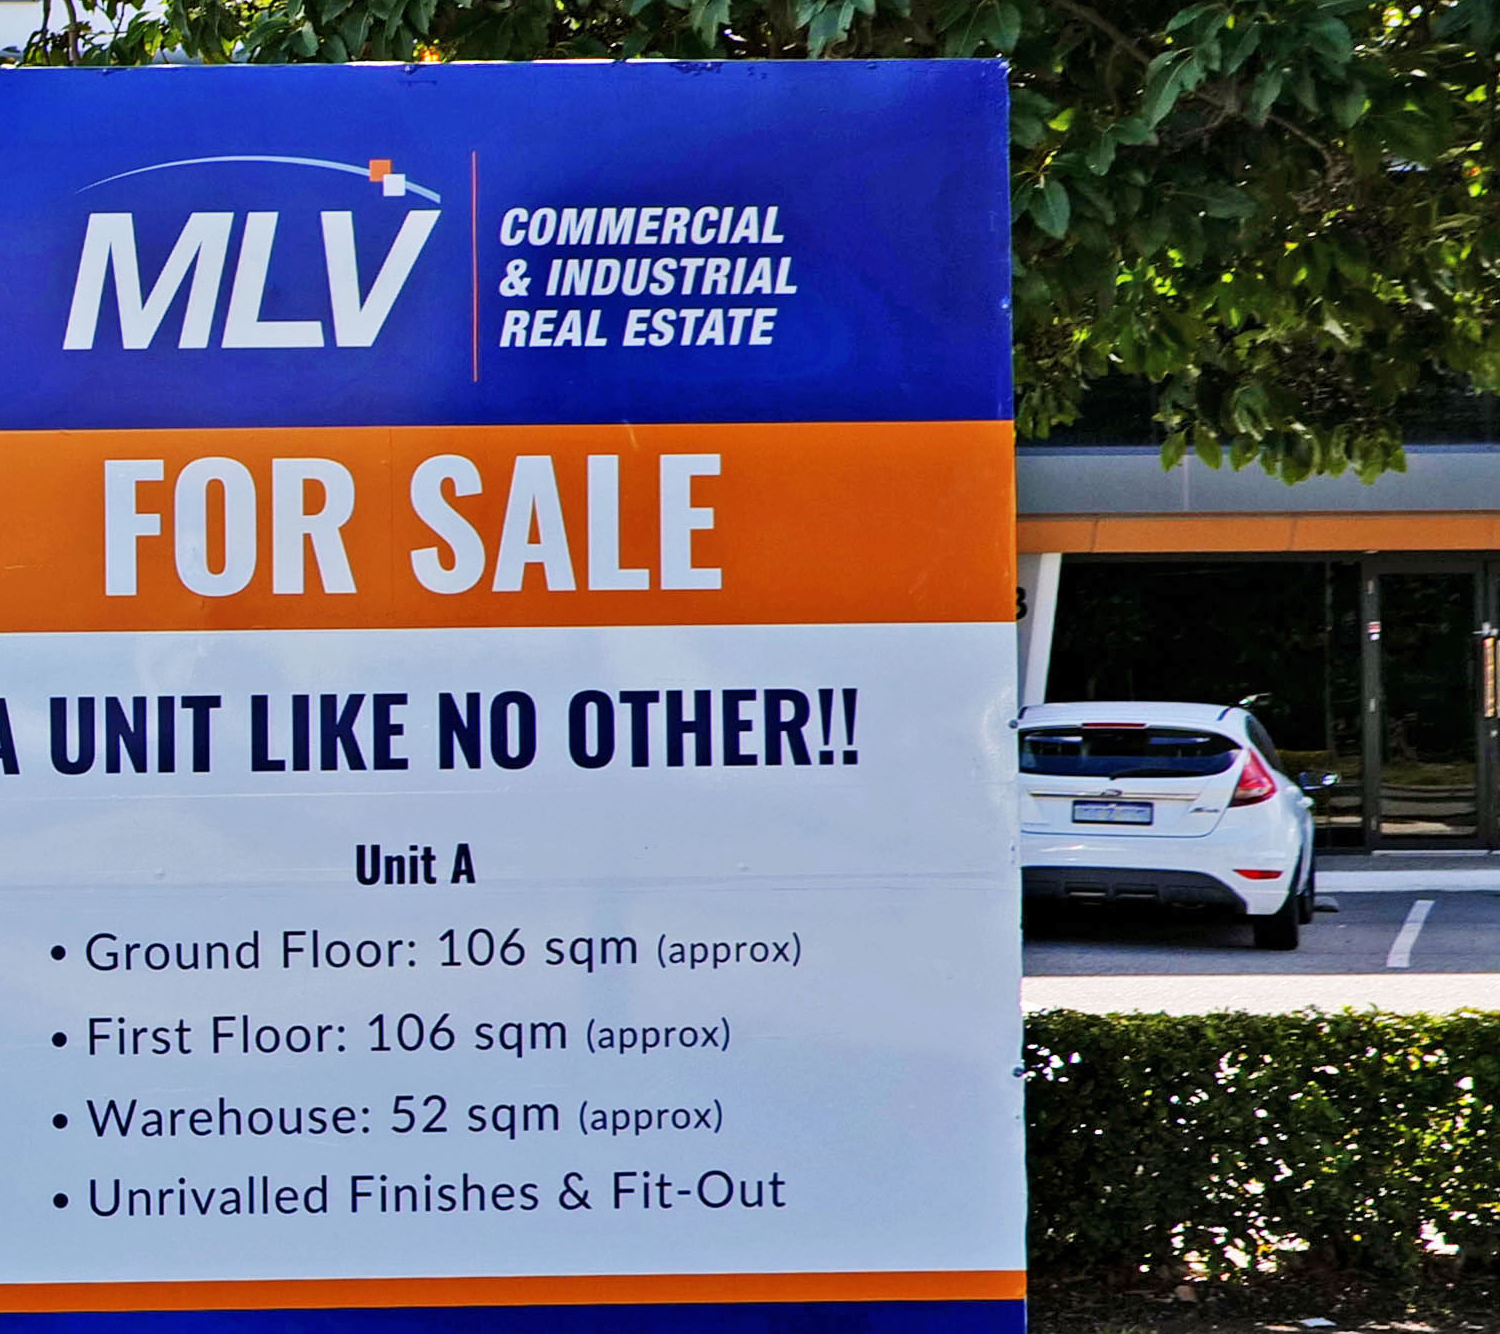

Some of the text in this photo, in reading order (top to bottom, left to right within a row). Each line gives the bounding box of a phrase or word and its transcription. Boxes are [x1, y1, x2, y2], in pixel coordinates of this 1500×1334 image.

[500, 206, 784, 247] COMMERCIAL
[63, 211, 440, 349] MLV
[499, 257, 797, 296] & INDUSTRIAL
[500, 308, 778, 348] REAL ESTATE
[104, 454, 723, 597] FOR SALE
[50, 696, 222, 775] UNIT
[251, 694, 409, 772] LIKE
[439, 691, 536, 770] NO
[569, 688, 858, 769] OTHER!!
[357, 844, 476, 886] Unit A
[86, 928, 801, 974] Ground Floor: 106 sqm (approx)
[89, 1014, 730, 1059] First Floor: 106 sqm (approx)
[87, 1095, 723, 1141] Warehouse: 52 sqm (approx)
[90, 1171, 786, 1217] Unrivalled Finishes & Fit-Out
